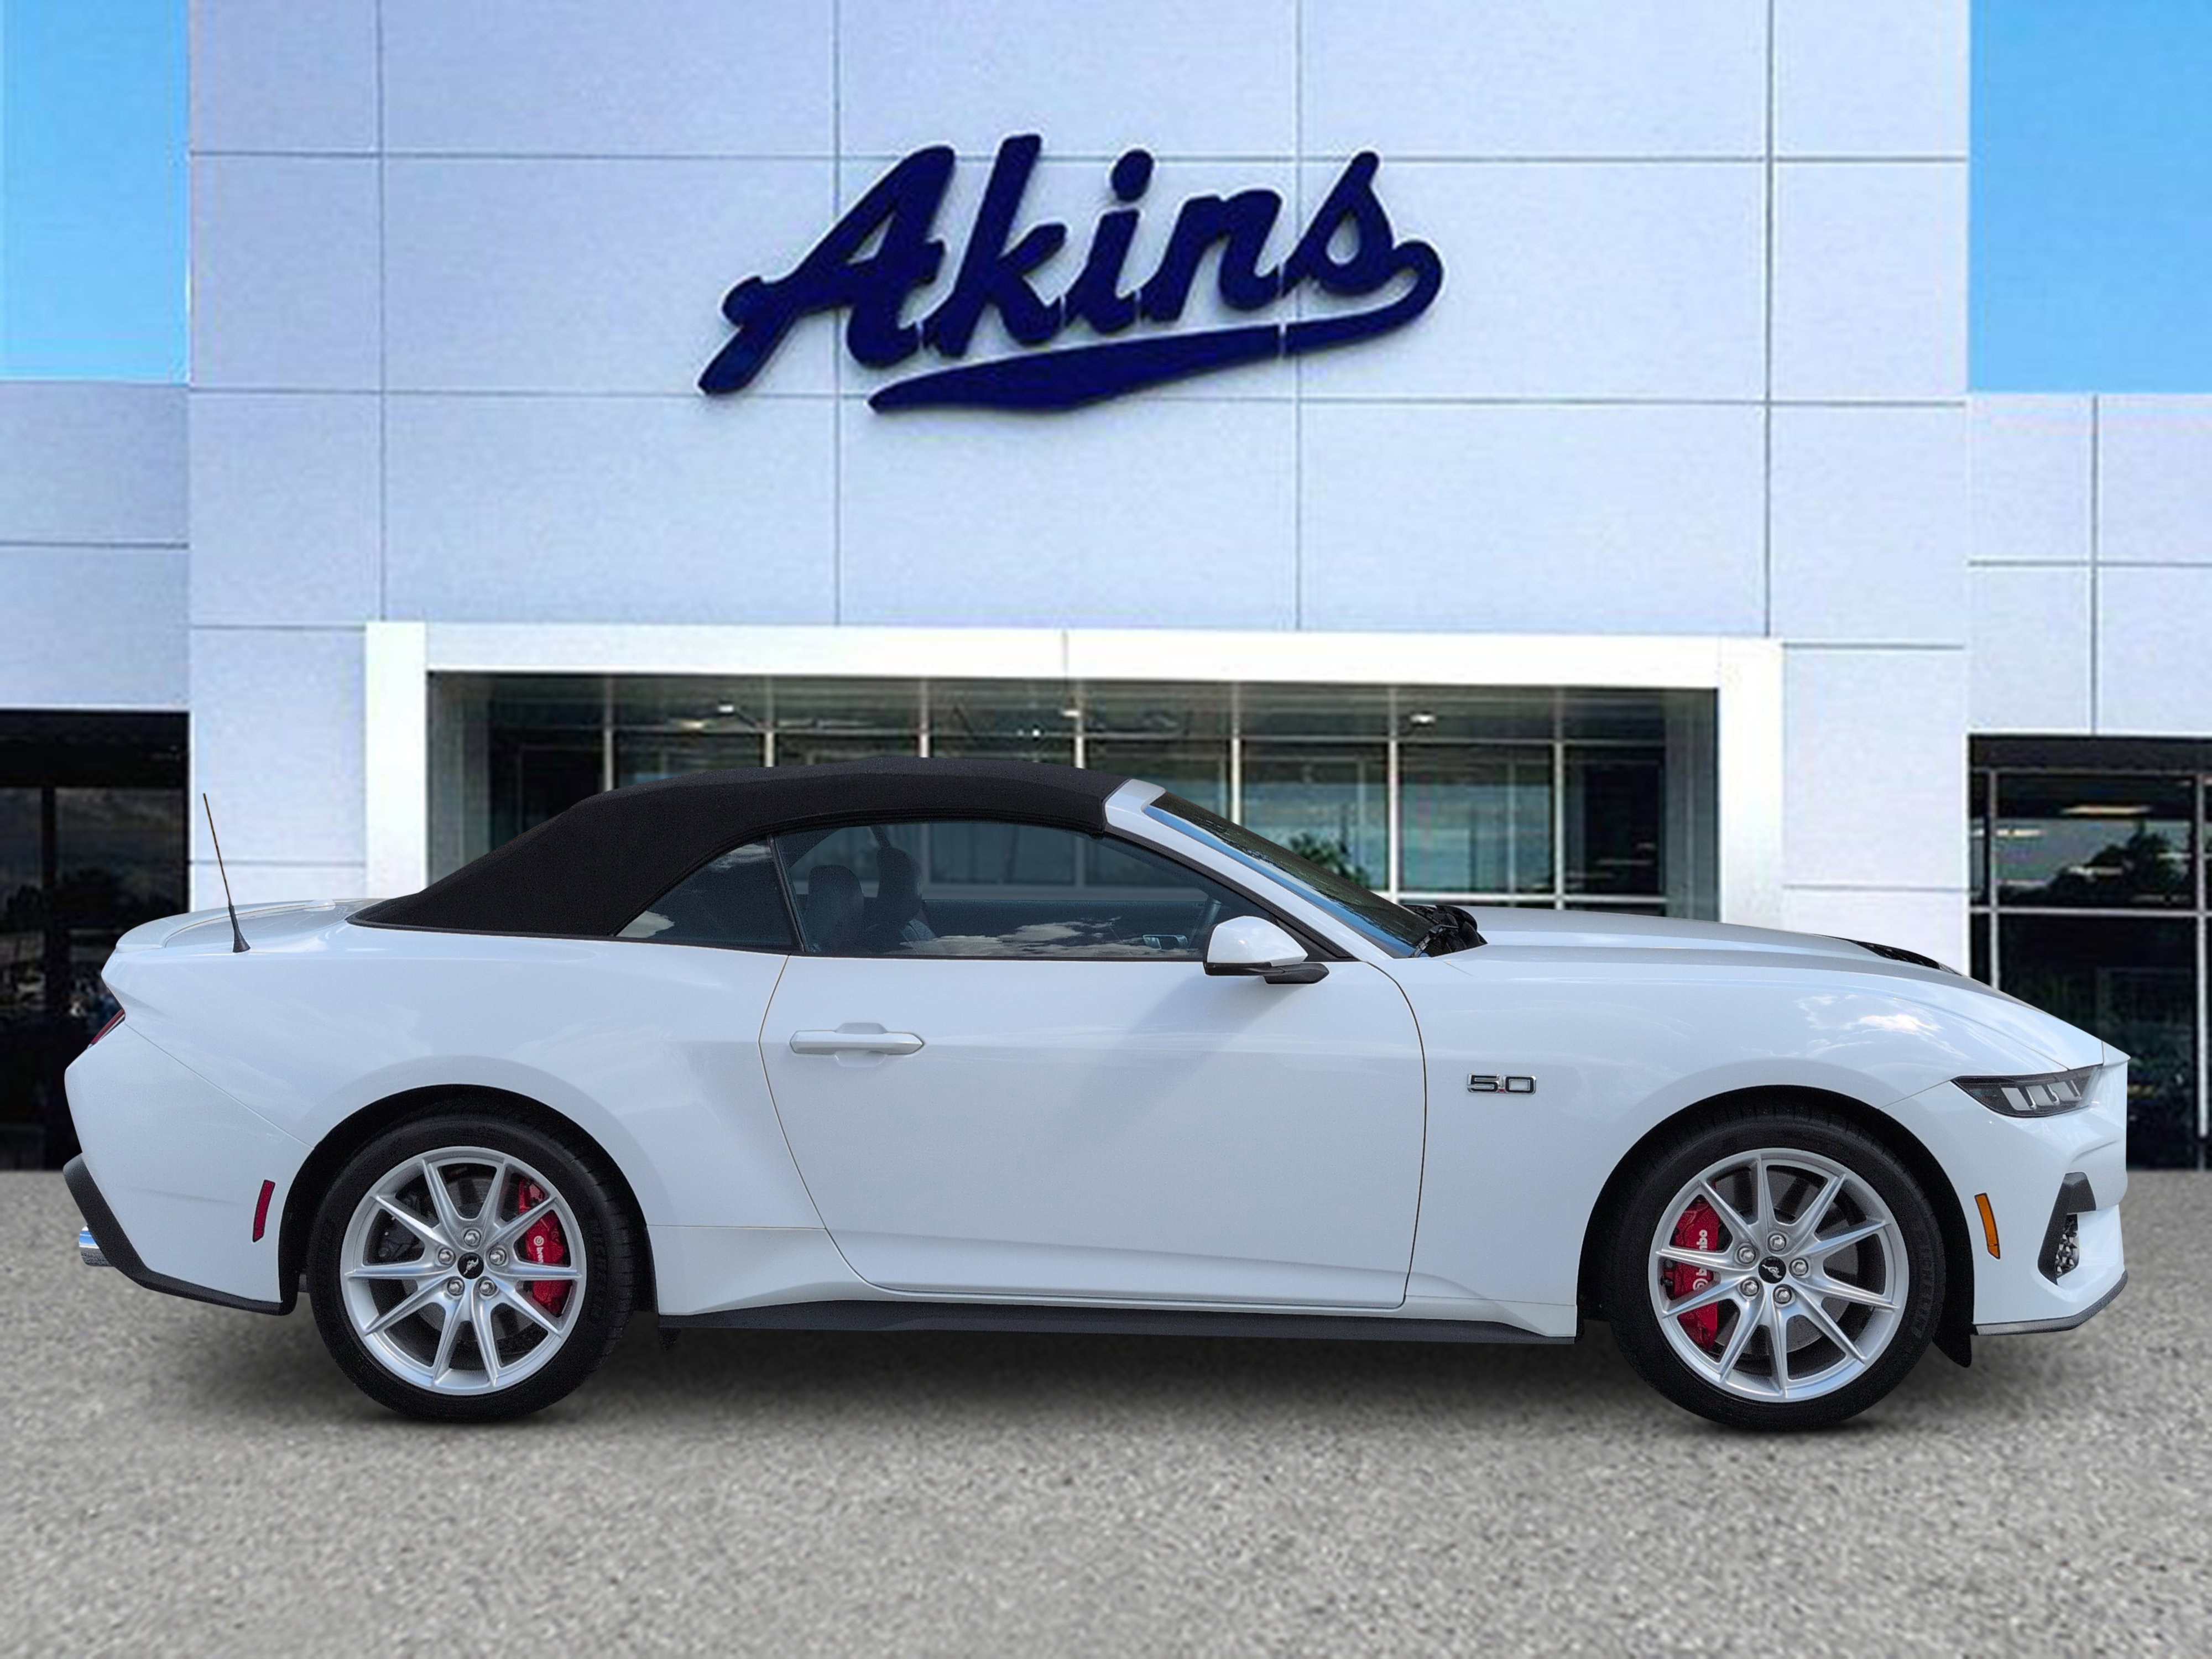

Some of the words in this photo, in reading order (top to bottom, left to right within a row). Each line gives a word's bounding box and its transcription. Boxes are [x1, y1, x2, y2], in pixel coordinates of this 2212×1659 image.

[698, 135, 1443, 414] Akins
[1467, 1073, 1536, 1094] 5.0
[1696, 1229, 1708, 1276] bbo
